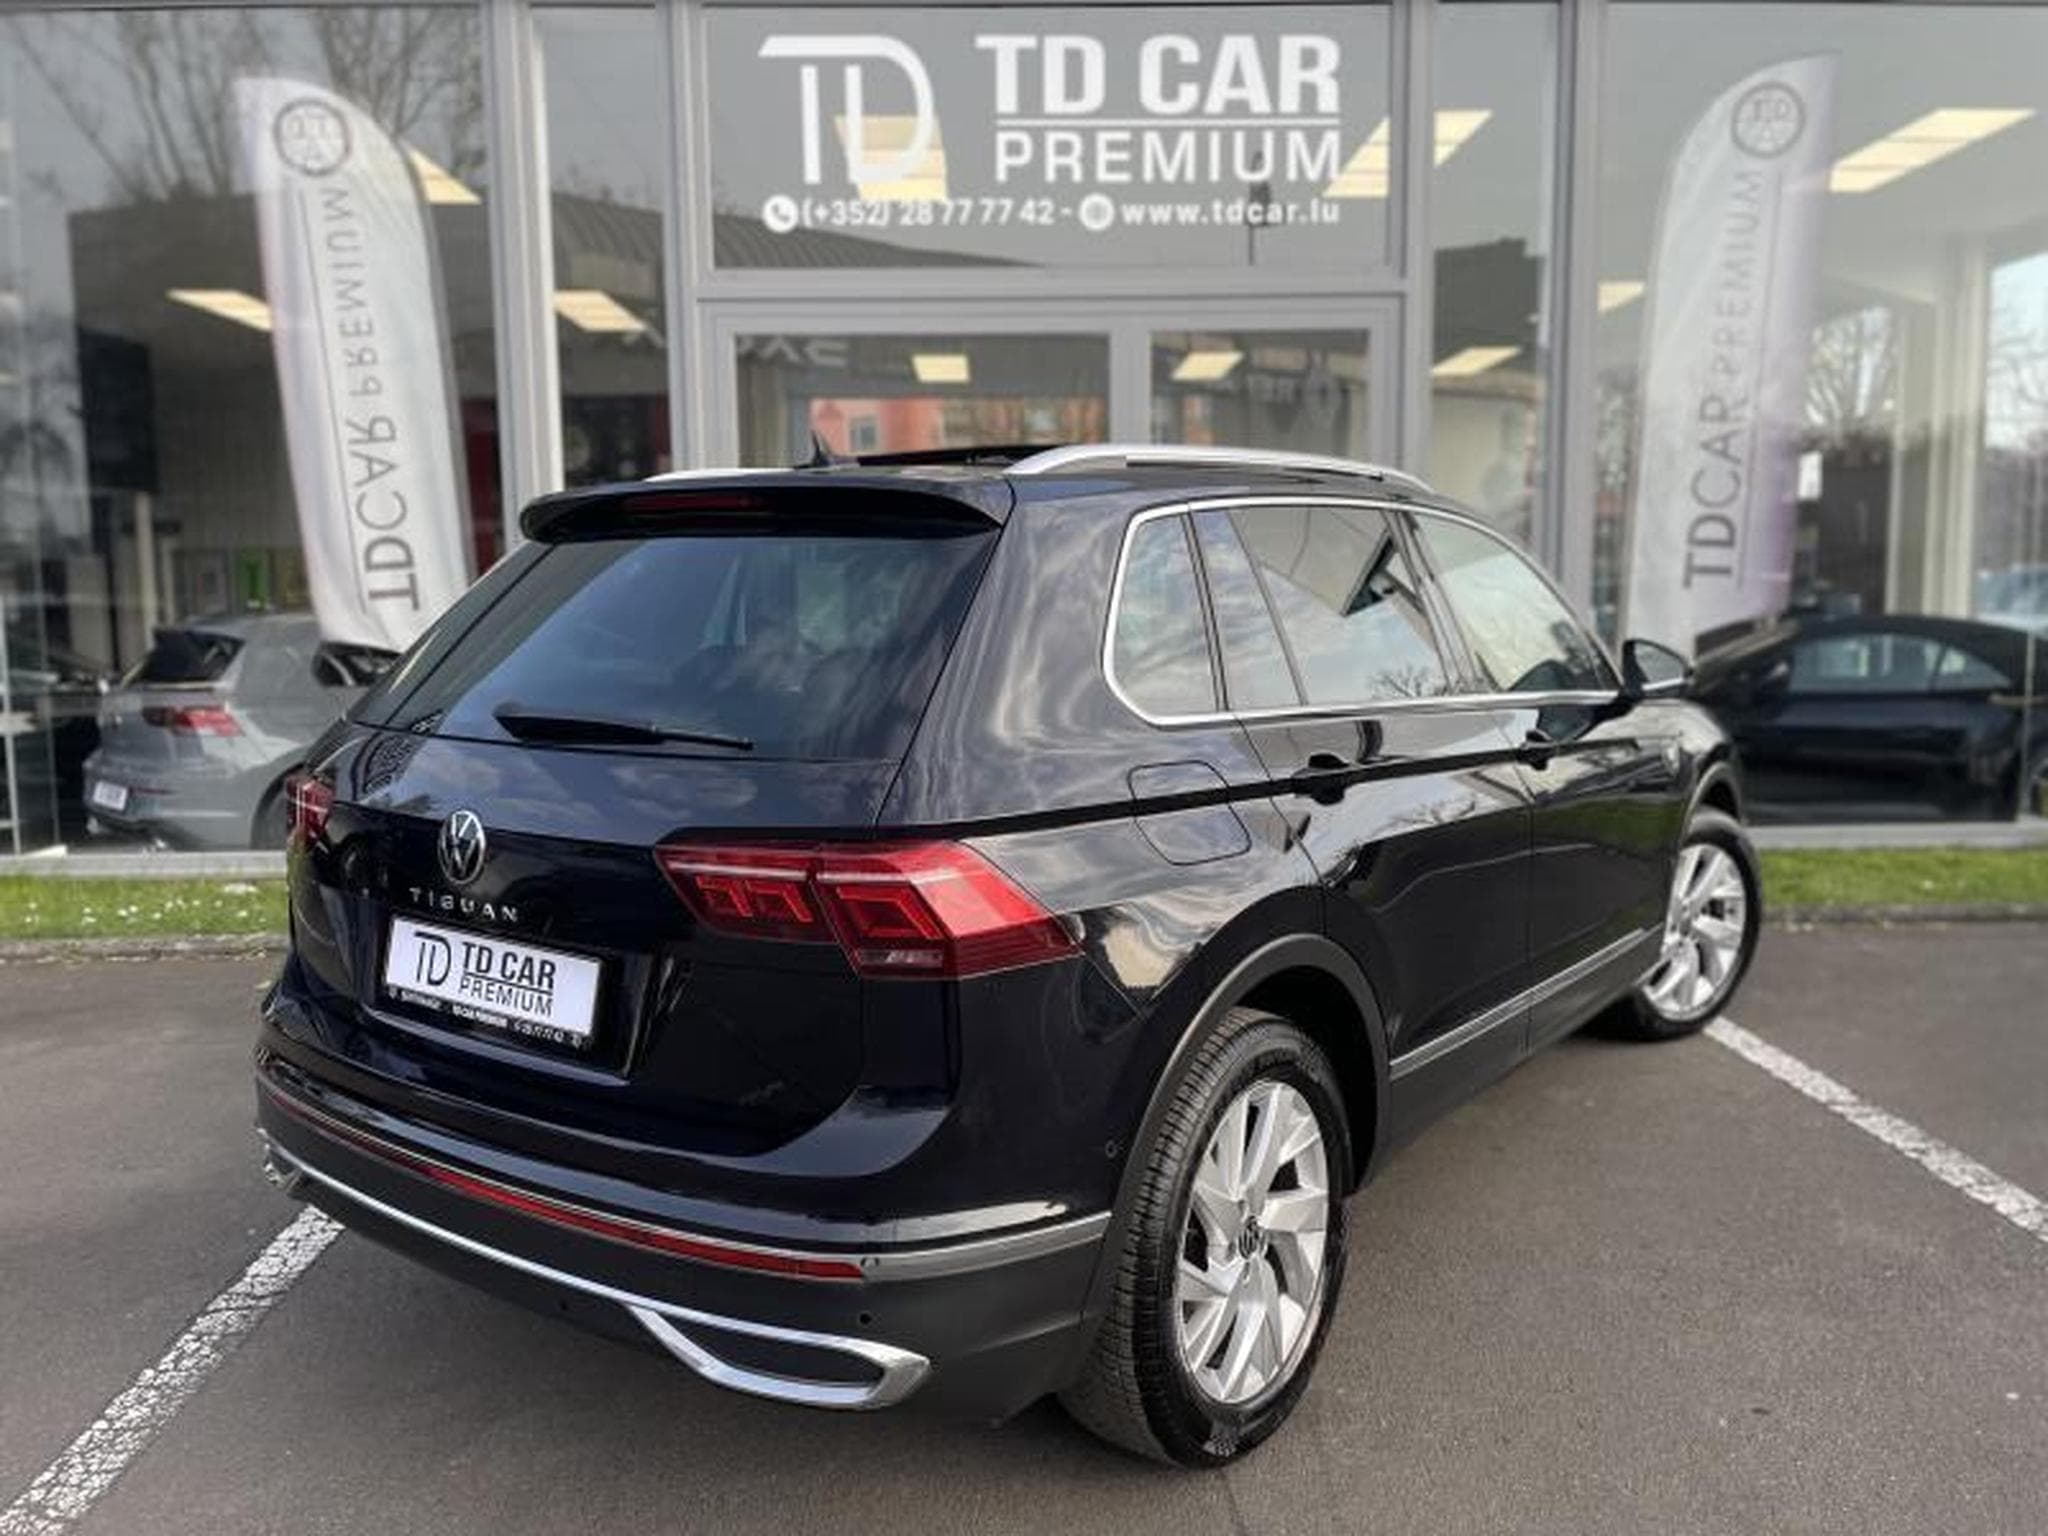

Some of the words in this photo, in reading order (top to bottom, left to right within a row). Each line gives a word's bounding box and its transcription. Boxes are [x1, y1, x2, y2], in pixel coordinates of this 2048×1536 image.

[975, 35, 1105, 115] TD
[1138, 34, 1341, 115] CAR
[995, 131, 1341, 184] PREMIUM
[802, 198, 891, 228] (+352)
[900, 201, 934, 226] 28
[1019, 200, 1056, 225] 42
[1122, 198, 1340, 225] www.tdcar.lu
[1711, 169, 1765, 380] PREMIUM
[1683, 394, 1748, 590] TDCAR
[408, 887, 518, 923] TIGUAN
[460, 941, 494, 975] TD
[500, 951, 557, 990] CAR
[458, 975, 554, 1019] PREMIUM
